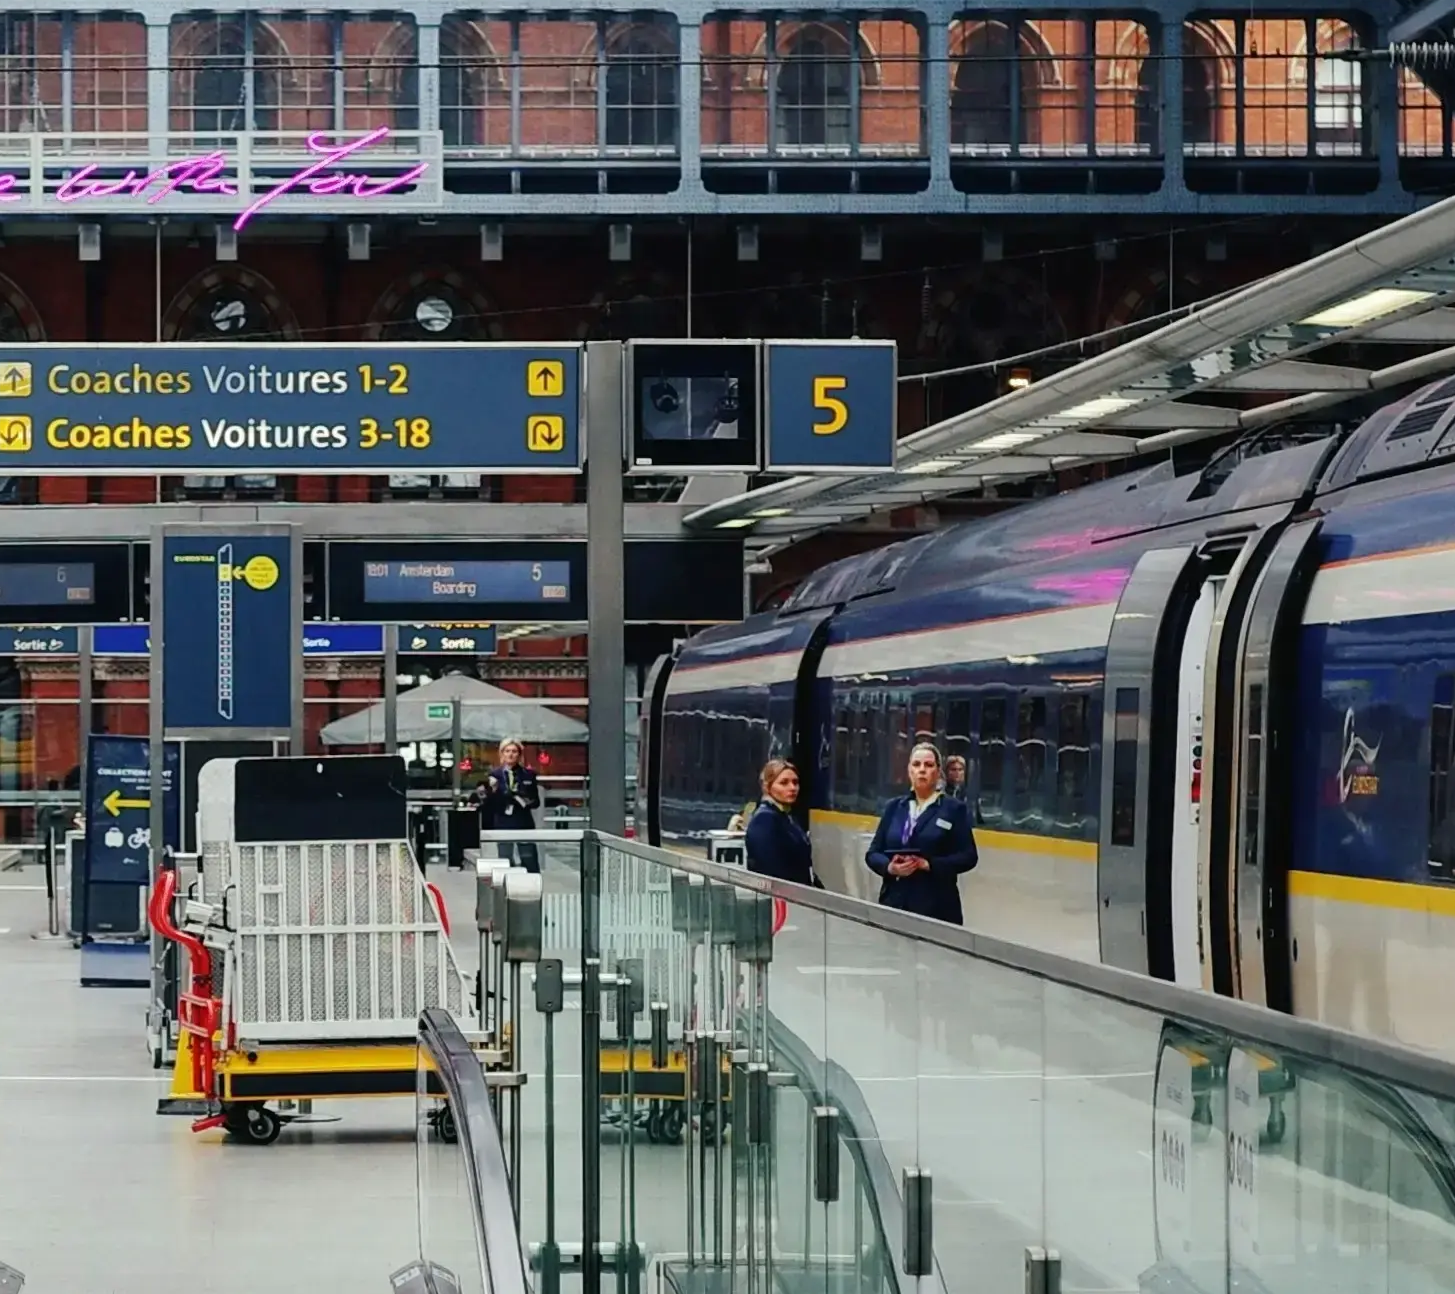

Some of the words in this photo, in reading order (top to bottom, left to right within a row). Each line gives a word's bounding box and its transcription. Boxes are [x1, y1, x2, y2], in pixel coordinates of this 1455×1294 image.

[48, 363, 191, 394] Coaches
[202, 364, 348, 394] Voitures
[358, 364, 409, 394] 1-2
[812, 376, 849, 435] 5
[47, 417, 192, 448] Coaches
[201, 418, 348, 448] Voitures
[359, 418, 431, 448] 3-18
[56, 566, 67, 583] 6
[399, 564, 455, 577] Amsterdam
[531, 563, 542, 581] 5
[432, 581, 476, 597] Boarding
[14, 639, 47, 651] Sortie
[440, 637, 476, 650] Sortie
